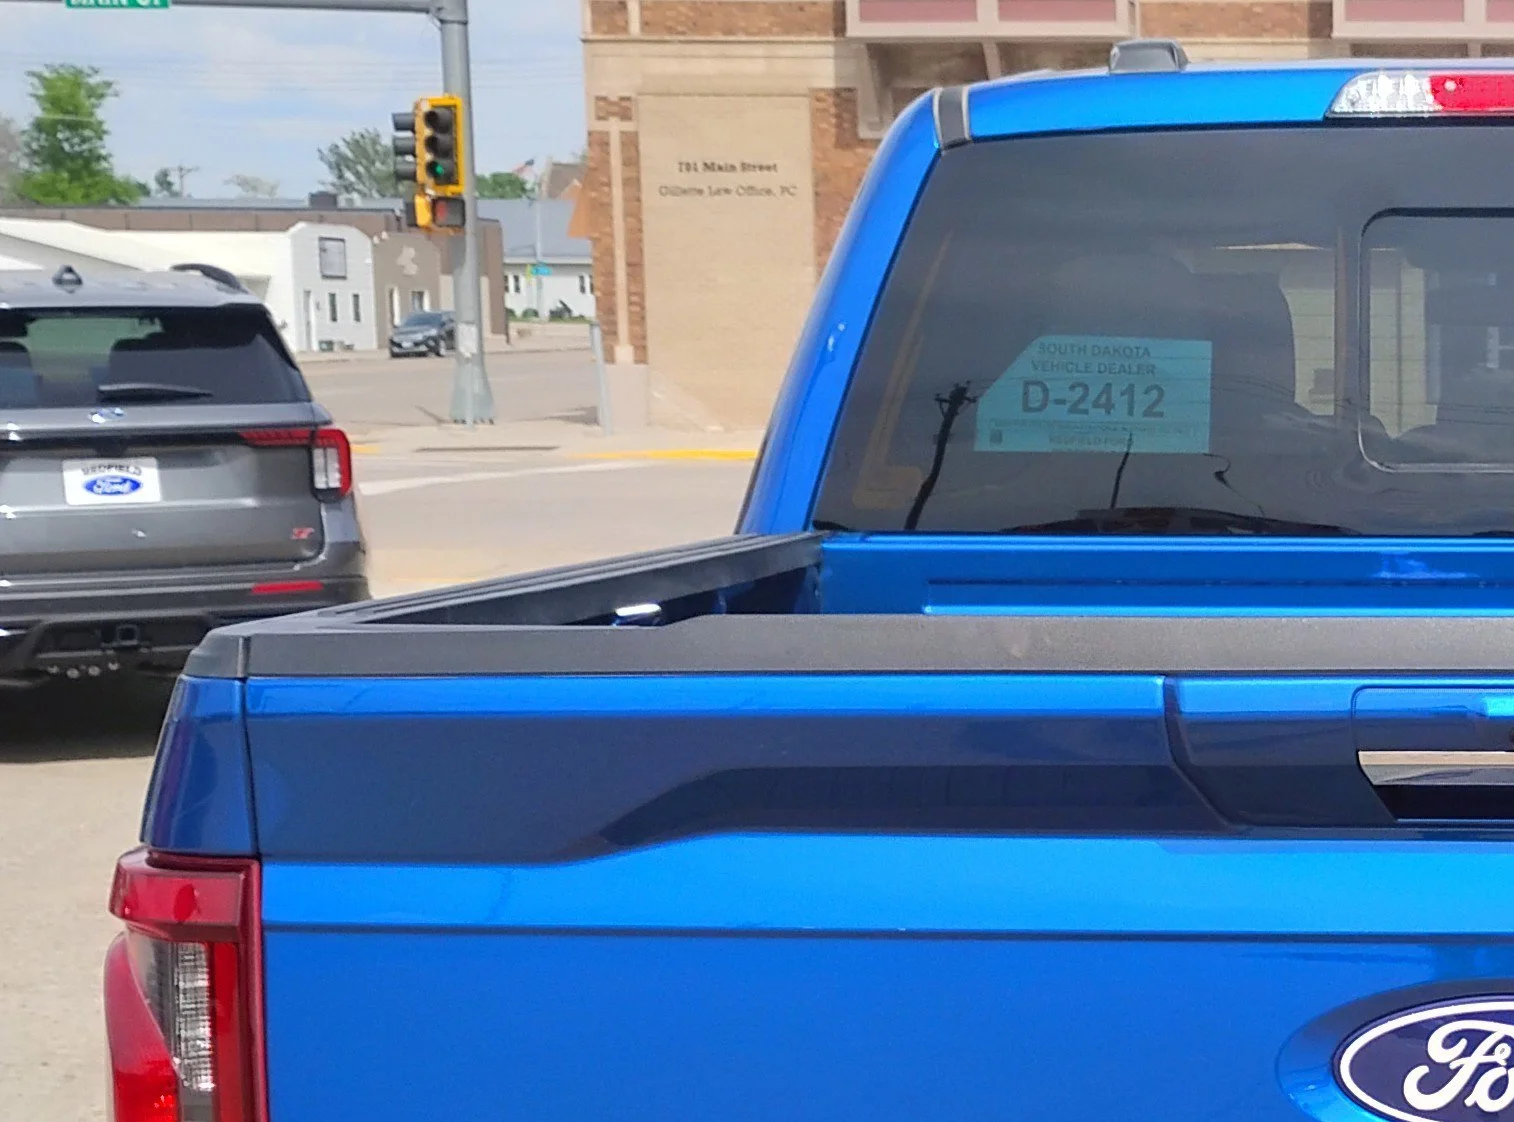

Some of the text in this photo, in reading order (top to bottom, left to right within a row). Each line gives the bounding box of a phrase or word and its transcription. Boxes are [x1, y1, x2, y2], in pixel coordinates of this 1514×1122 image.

[702, 161, 737, 173] Main
[740, 162, 778, 173] Street
[1038, 342, 1151, 358] SOUTH DAKOTA
[1031, 360, 1156, 376] VEHICLE DEALER
[1021, 379, 1166, 418] D-2412
